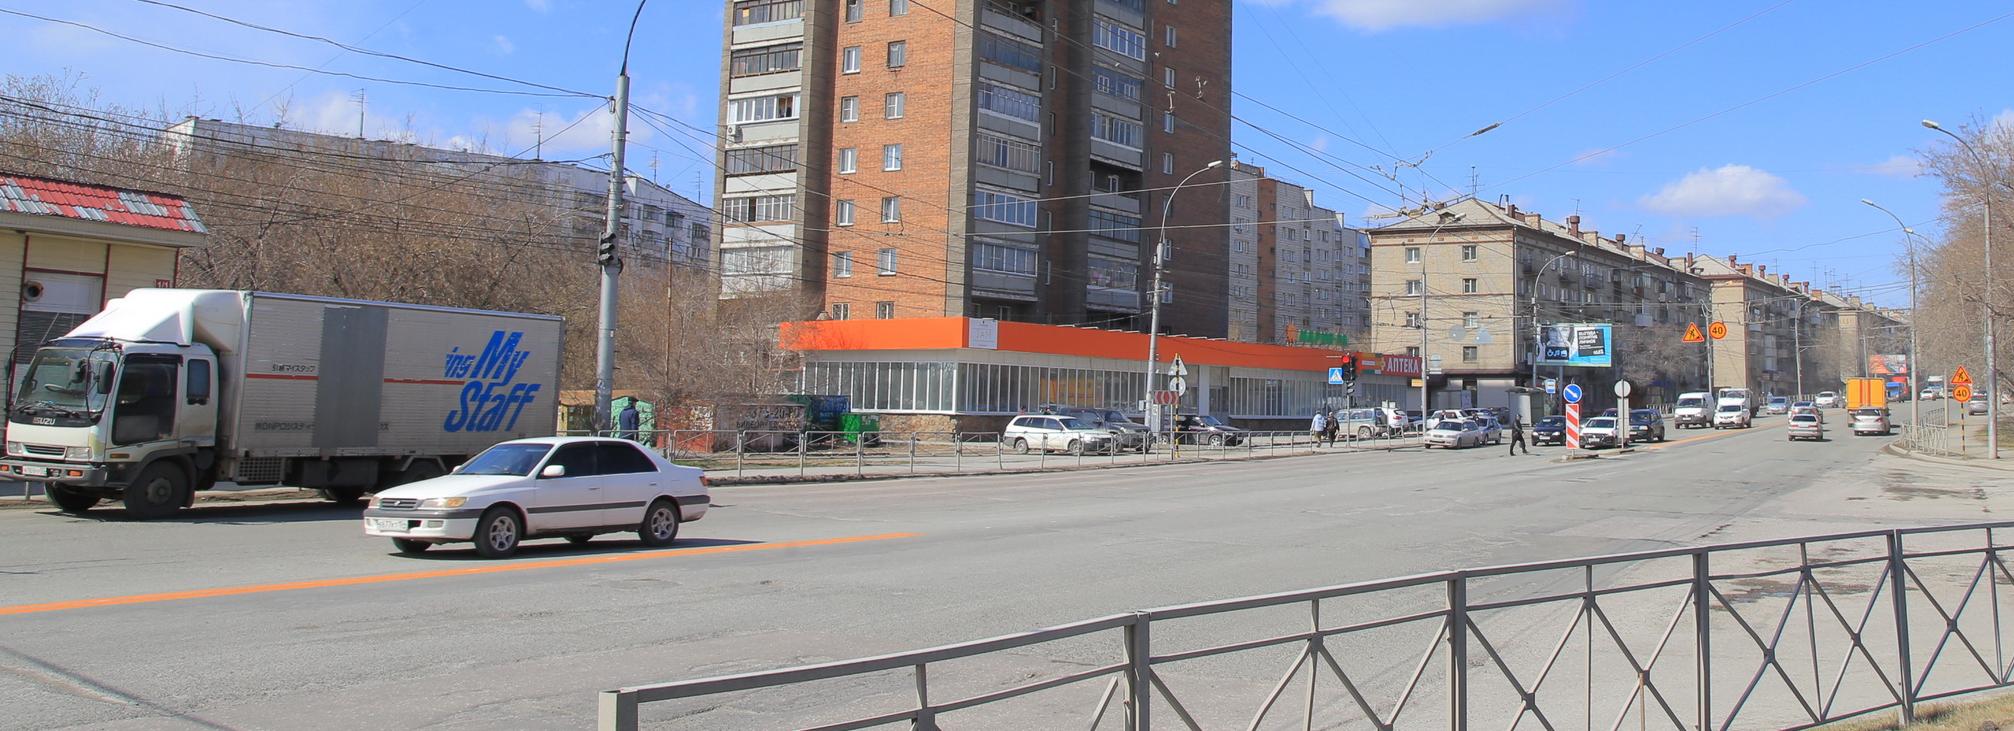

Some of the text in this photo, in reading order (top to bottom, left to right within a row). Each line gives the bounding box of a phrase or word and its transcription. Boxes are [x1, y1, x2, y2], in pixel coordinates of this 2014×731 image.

[1712, 326, 1724, 335] 40
[469, 330, 530, 387] My
[1387, 357, 1419, 374] АПТЕКА
[1956, 389, 1967, 398] 40
[443, 380, 542, 433] Staff
[32, 416, 56, 425] ISUZU
